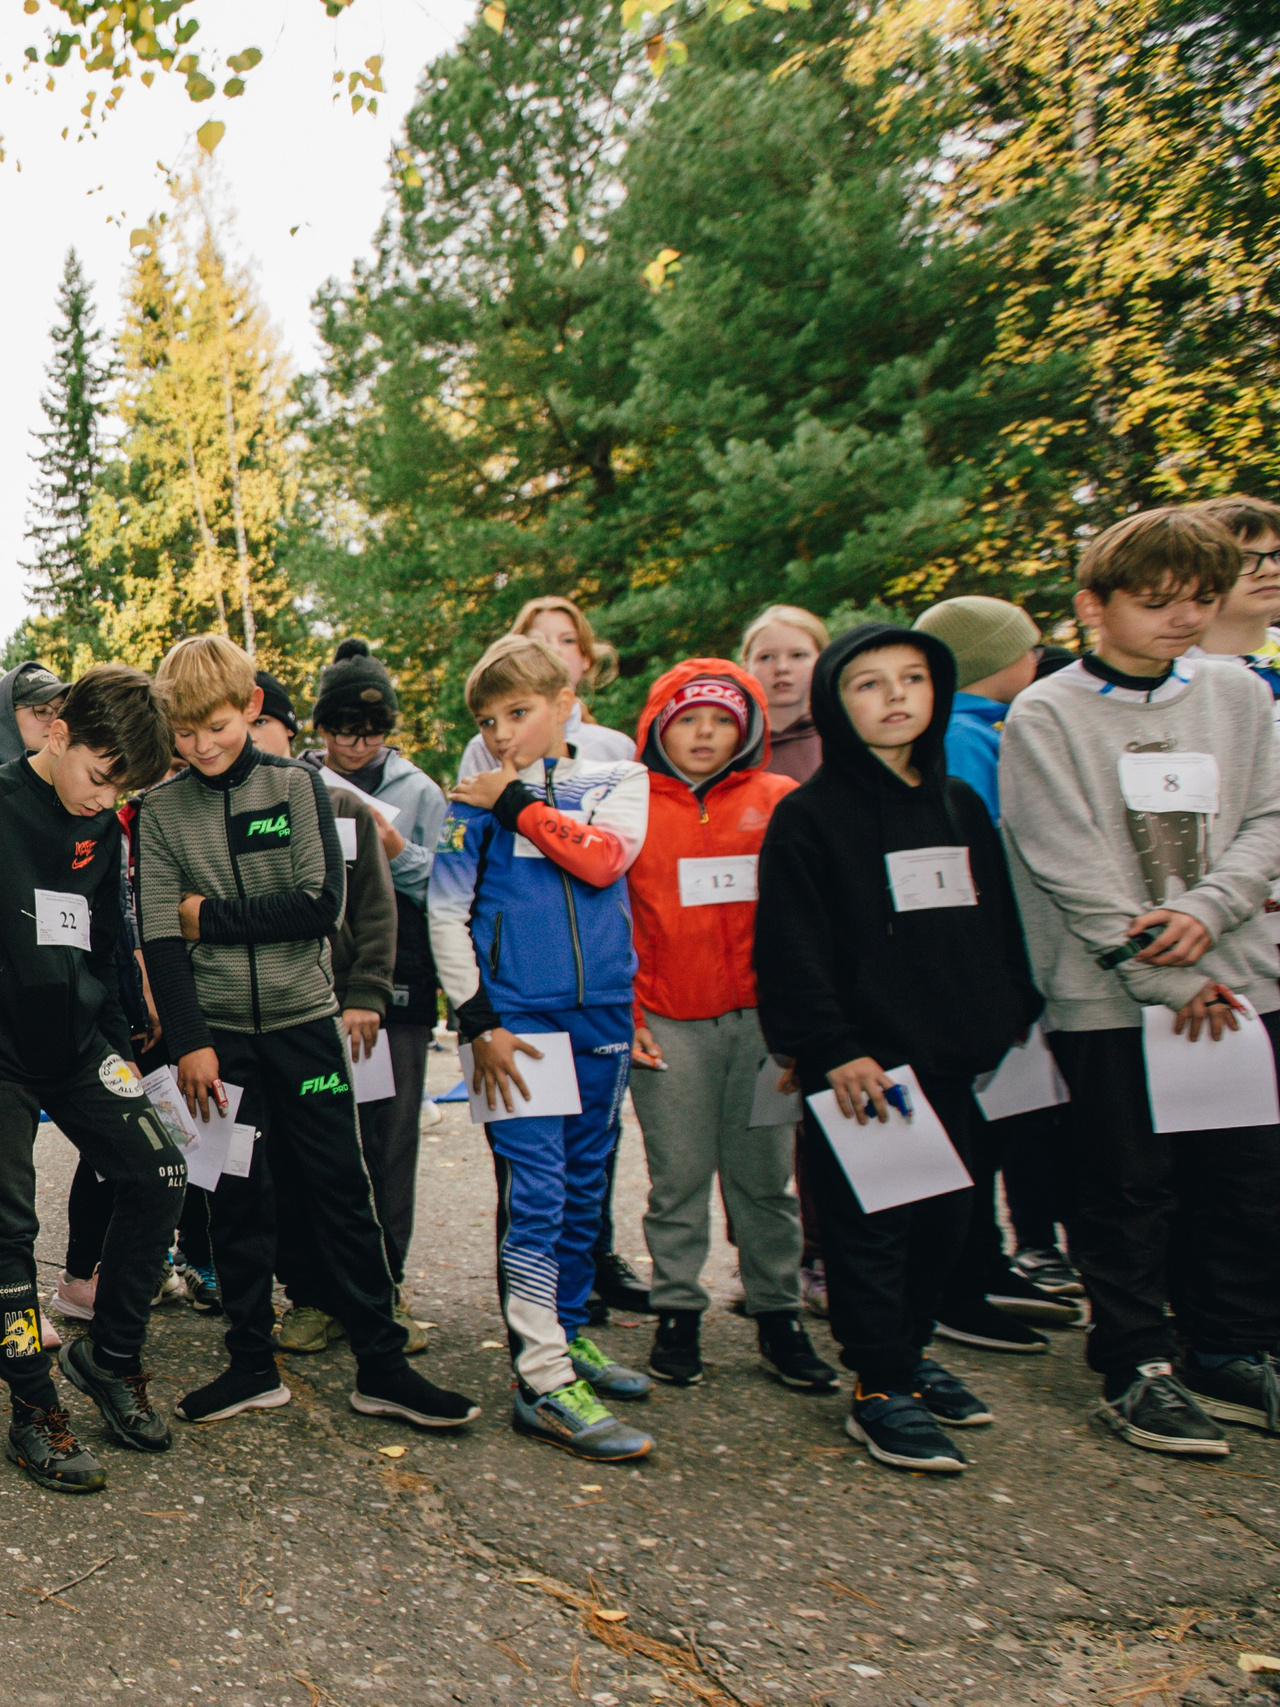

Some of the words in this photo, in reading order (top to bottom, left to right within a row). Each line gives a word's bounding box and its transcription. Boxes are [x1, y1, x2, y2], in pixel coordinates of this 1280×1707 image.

[1162, 773, 1180, 793] 8
[247, 813, 289, 837] FILA
[711, 873, 736, 889] 12
[934, 870, 945, 889] 1
[60, 910, 77, 930] 22
[299, 1071, 340, 1096] FILA
[332, 1083, 349, 1095] PRO
[167, 1177, 183, 1188] ALL
